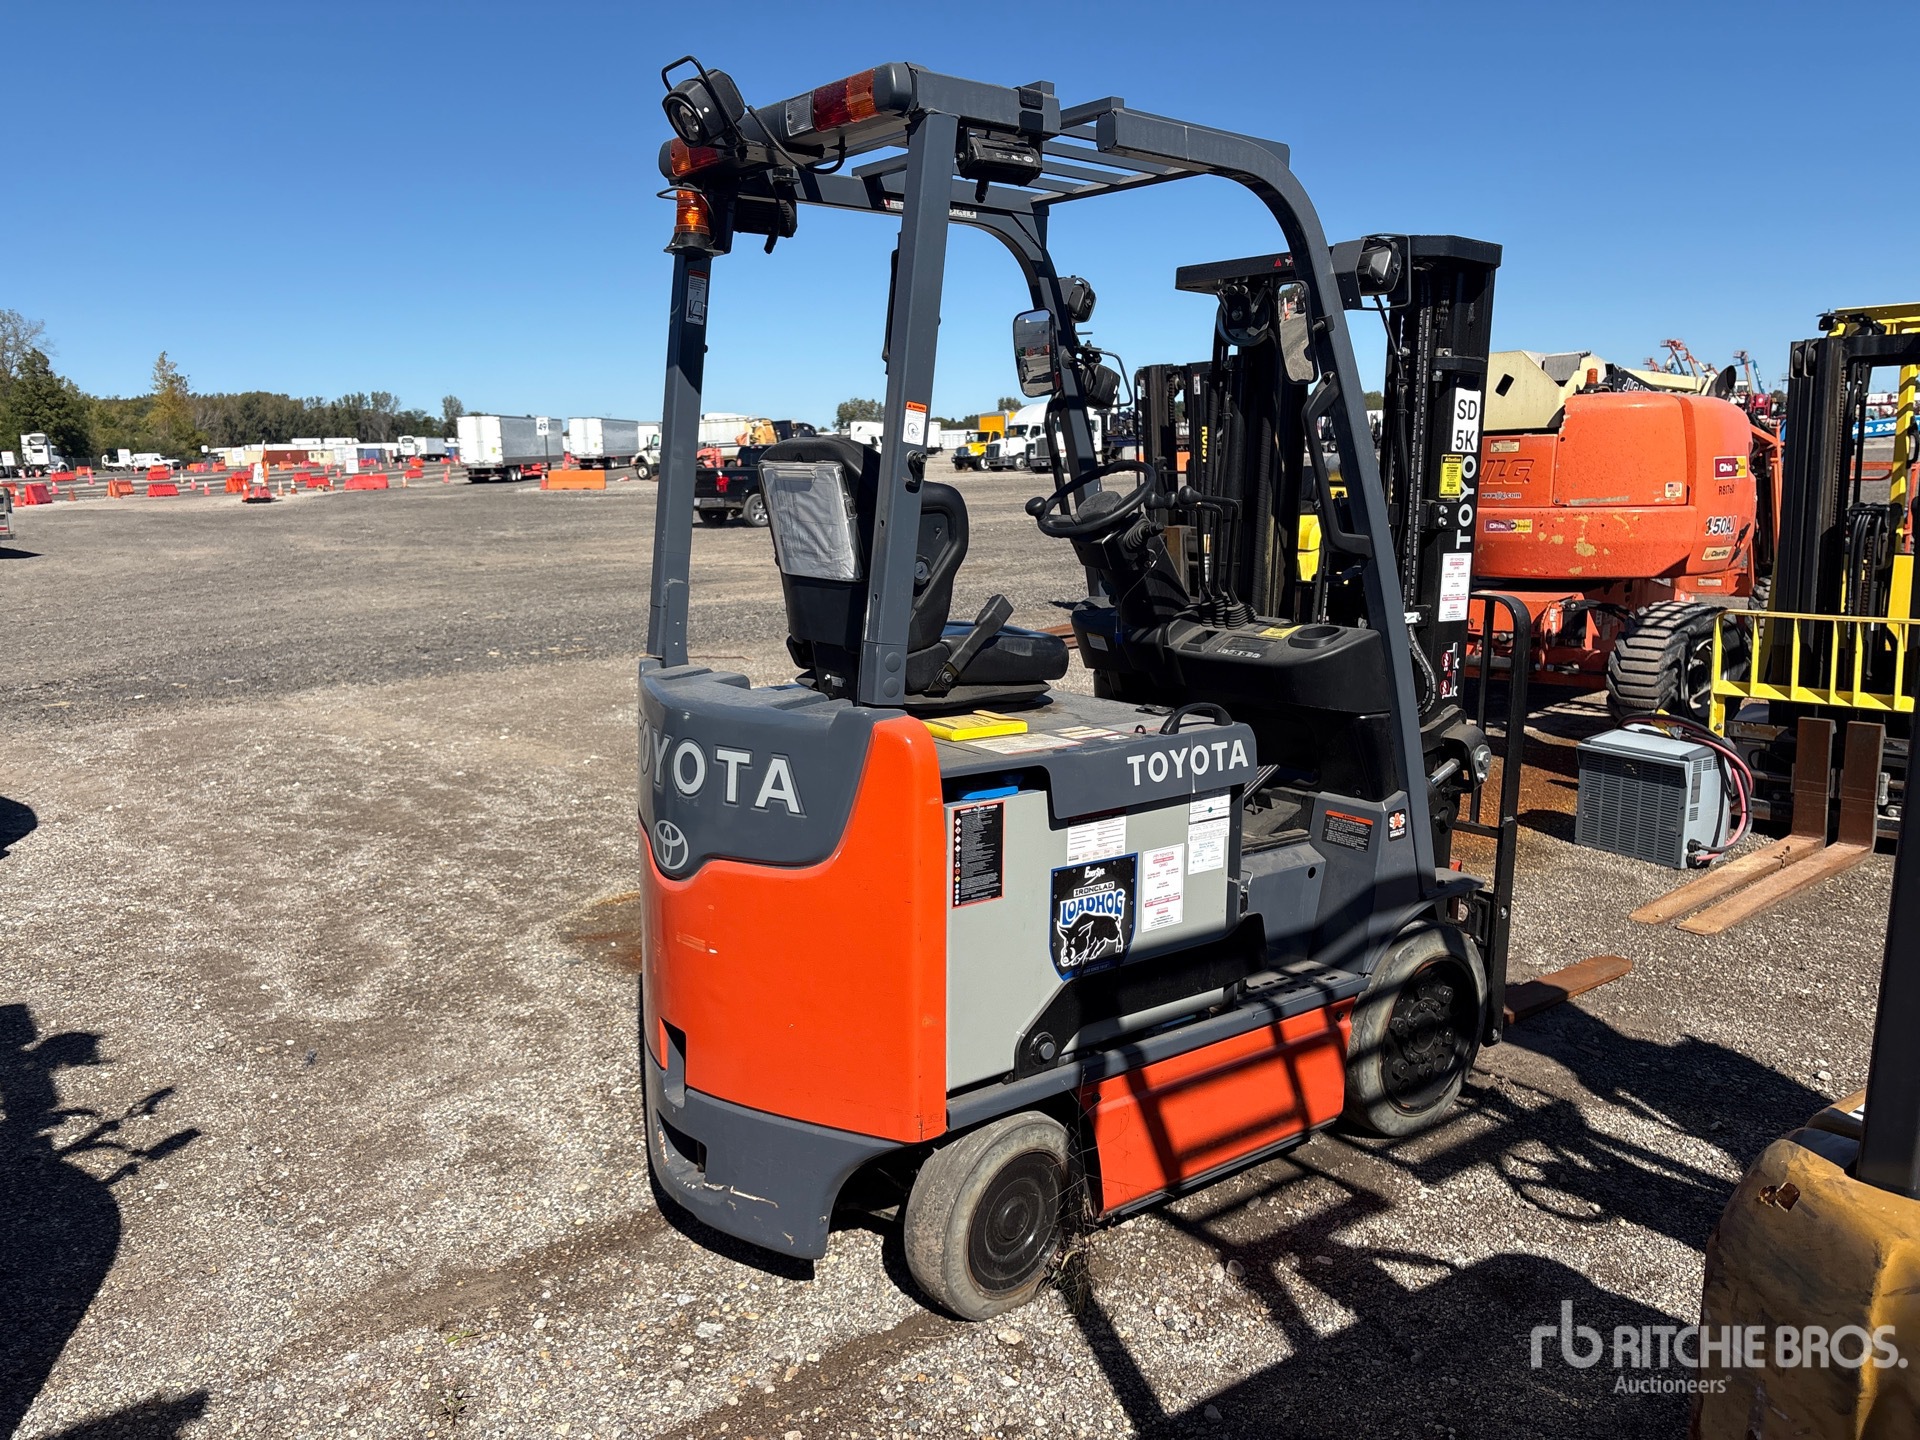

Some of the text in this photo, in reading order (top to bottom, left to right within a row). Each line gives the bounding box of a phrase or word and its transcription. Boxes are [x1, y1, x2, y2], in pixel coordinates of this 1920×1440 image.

[1456, 399, 1478, 421] SD
[538, 422, 547, 431] 49
[1455, 429, 1476, 451] 5K
[1455, 455, 1477, 549] TOYO
[638, 714, 804, 815] OYOTA
[1127, 739, 1249, 786] TOYOTA
[1084, 866, 1106, 879] EnerSys
[1075, 882, 1114, 897] IRONCLAD
[1060, 889, 1126, 928] LOADHOG
